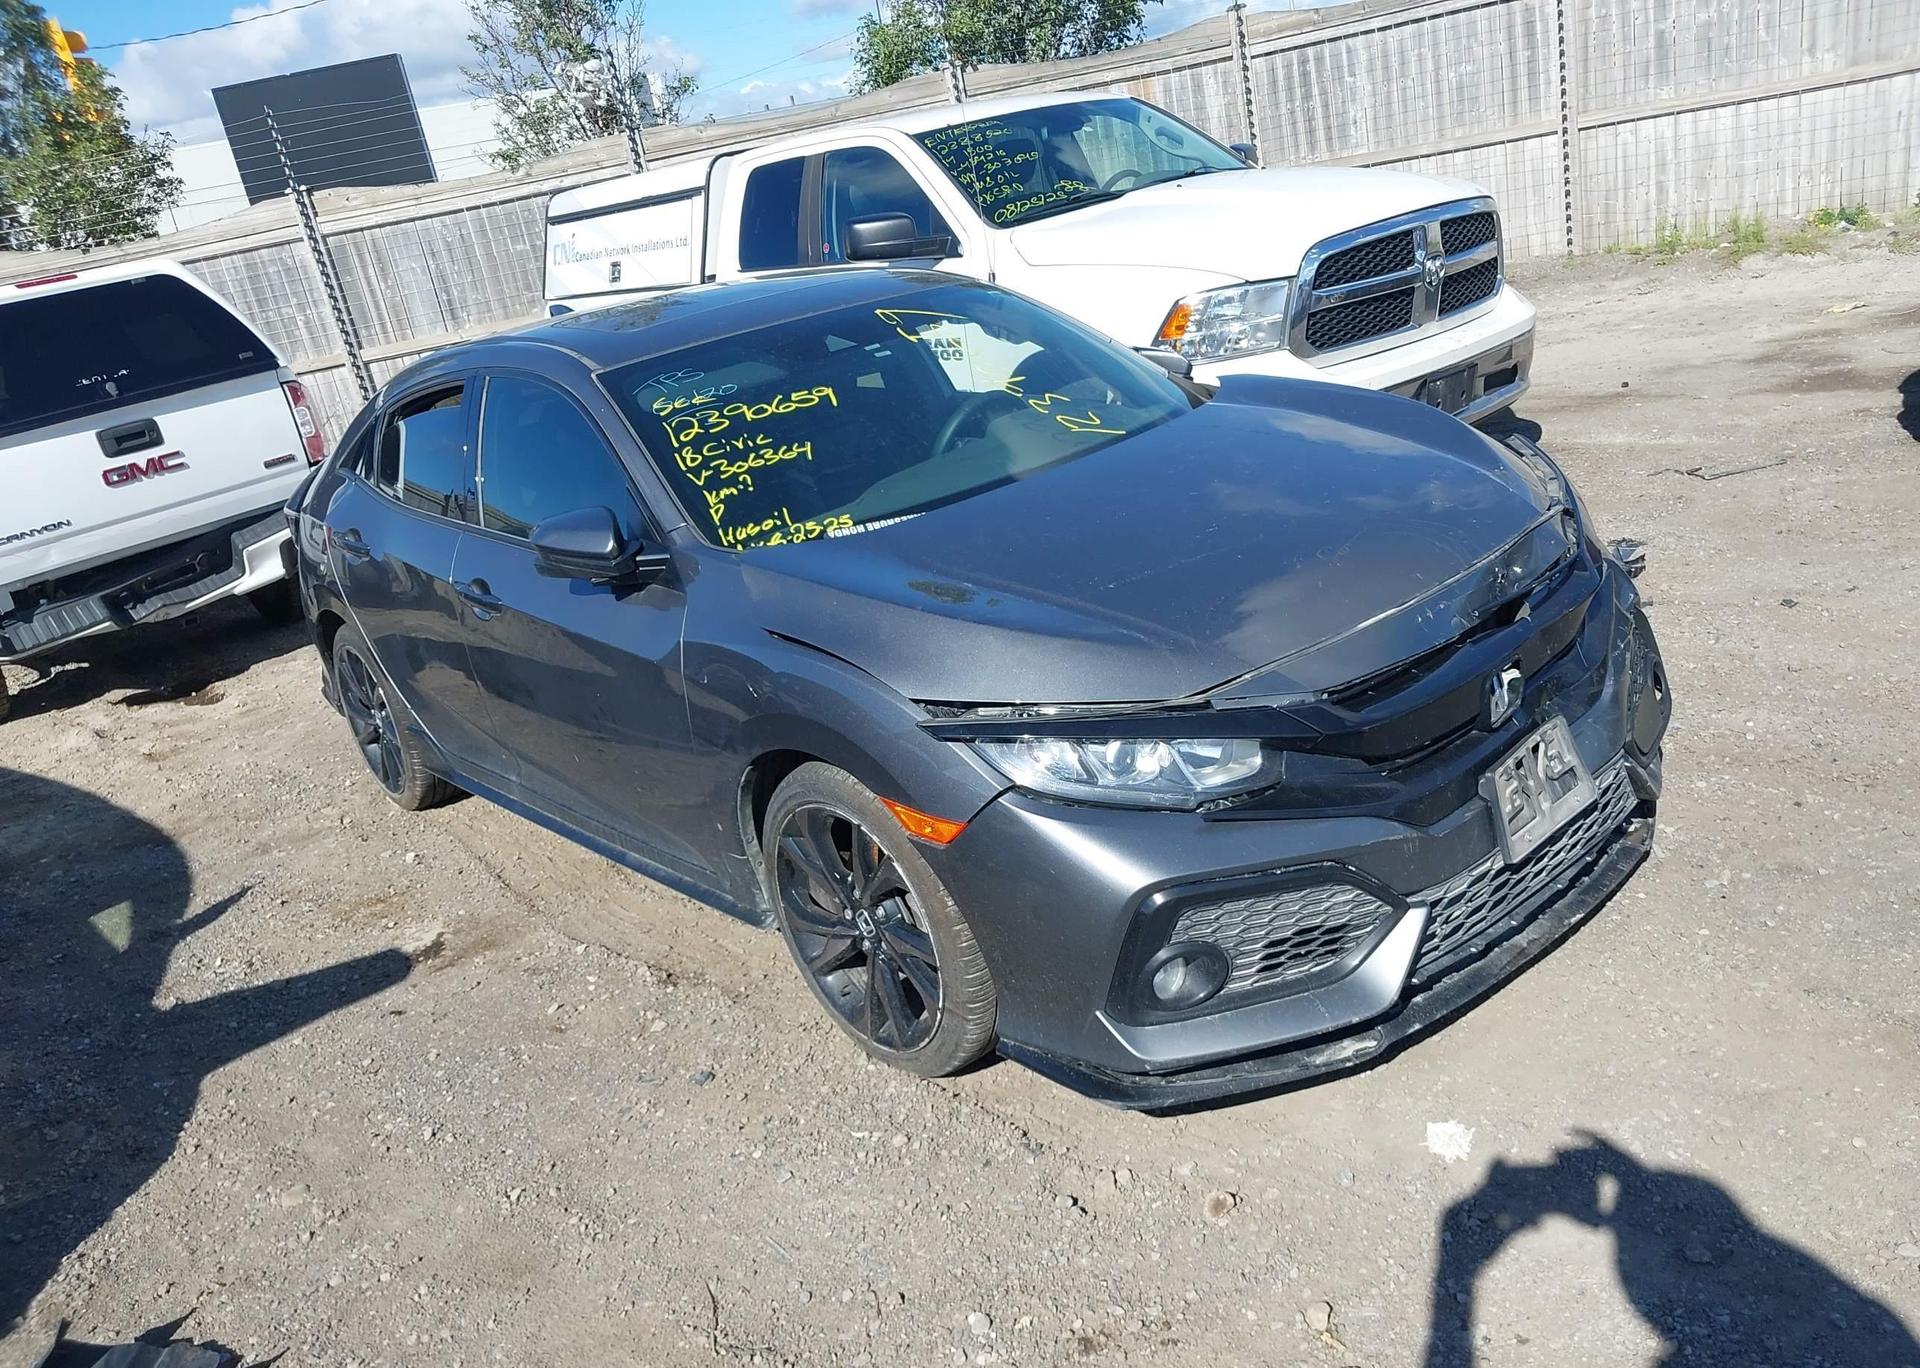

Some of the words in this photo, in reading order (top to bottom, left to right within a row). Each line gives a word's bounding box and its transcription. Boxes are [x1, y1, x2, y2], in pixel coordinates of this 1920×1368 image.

[575, 249, 603, 263] Canadian
[604, 245, 631, 258] Network
[631, 237, 674, 253] Installations
[675, 235, 690, 248] Ltd.
[662, 386, 839, 448] 12390659
[102, 450, 190, 488] GMC
[827, 524, 866, 539] HONDA
